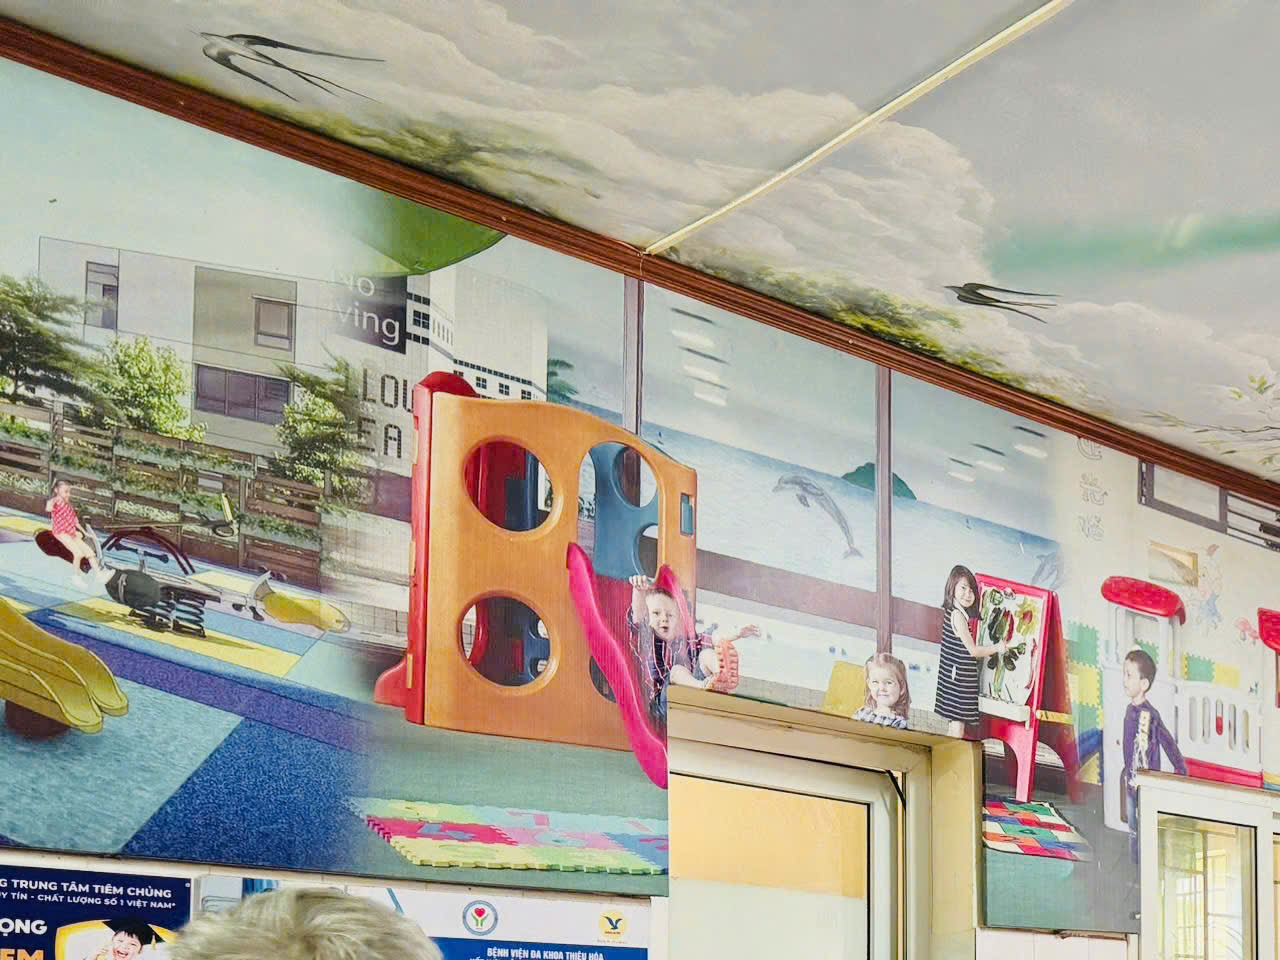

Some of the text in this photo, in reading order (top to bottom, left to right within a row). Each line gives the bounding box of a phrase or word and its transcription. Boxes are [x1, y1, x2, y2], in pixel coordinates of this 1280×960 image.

[12, 879, 58, 892] TRUNG
[61, 881, 89, 893] TÂM
[93, 882, 124, 896] TIÊM
[127, 884, 172, 899] CHỦNG
[11, 891, 28, 901] TÍN
[37, 893, 65, 903] CHẤT
[67, 895, 102, 906] LƯỢNG
[103, 897, 119, 907] SỐ
[126, 899, 148, 910] VIỆT
[543, 950, 564, 960] KHOA
